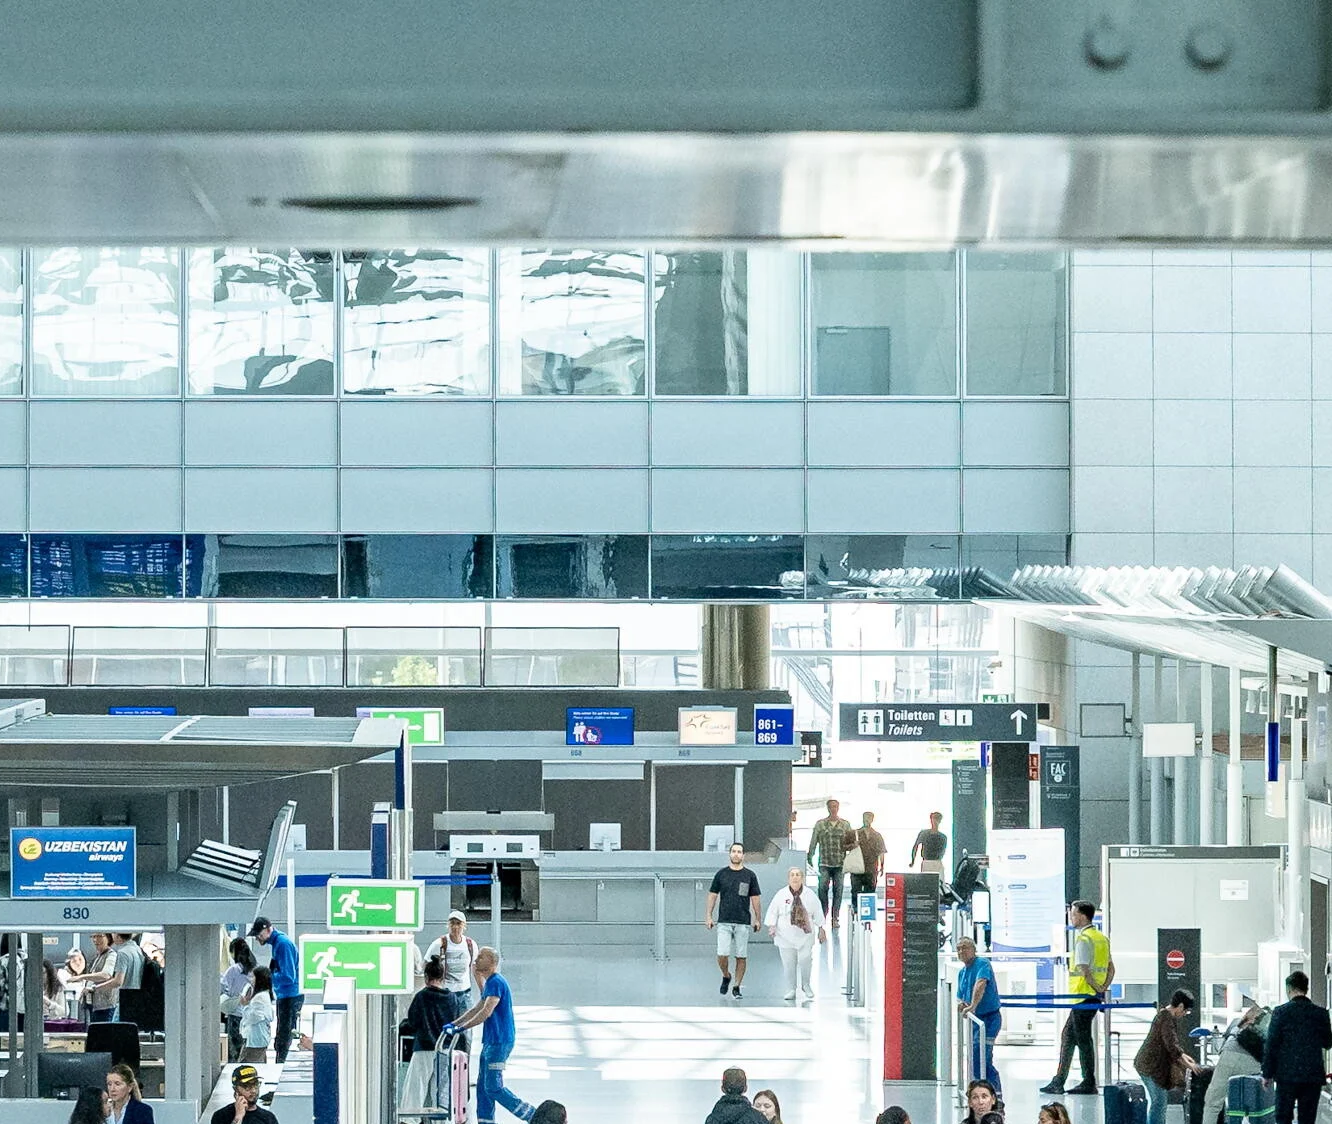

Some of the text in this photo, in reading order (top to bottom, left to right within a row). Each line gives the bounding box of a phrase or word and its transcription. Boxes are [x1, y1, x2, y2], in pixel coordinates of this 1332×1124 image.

[888, 709, 935, 721] Toiletten
[888, 724, 923, 736] Toilets
[758, 732, 778, 744] 869
[44, 840, 128, 853] UZBEKISTAN
[89, 853, 124, 863] airways
[63, 908, 90, 920] 830
